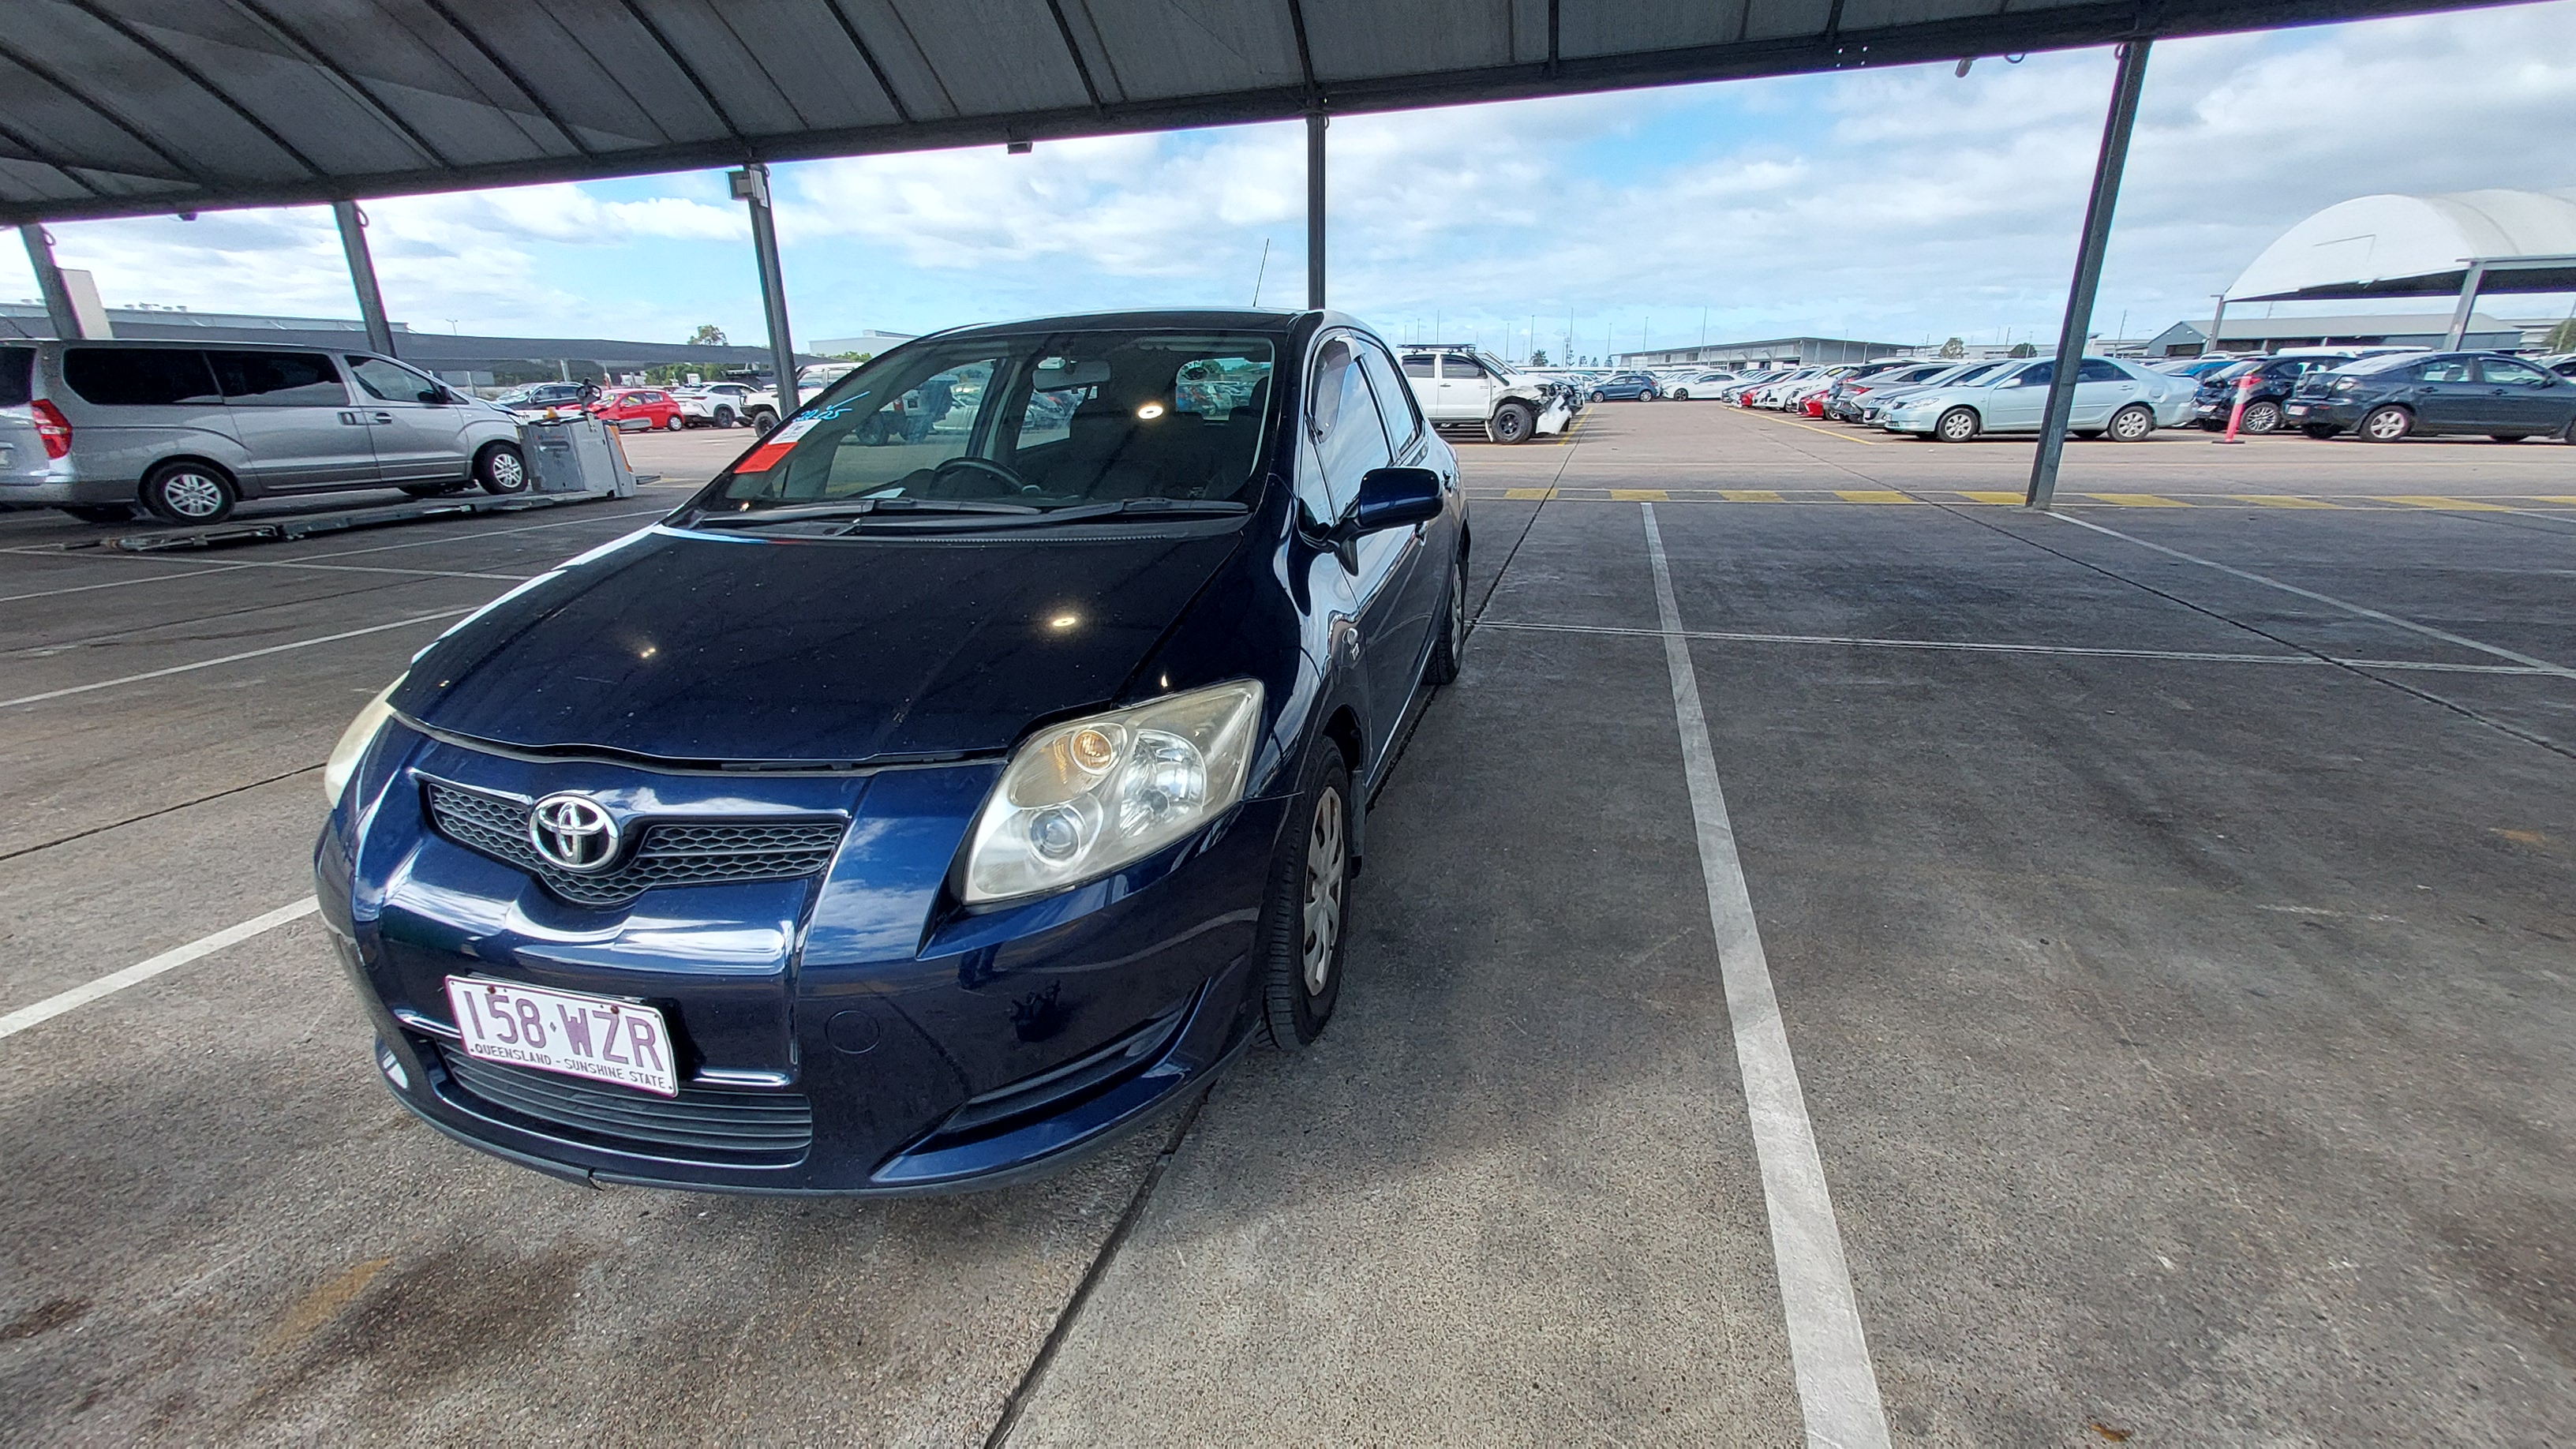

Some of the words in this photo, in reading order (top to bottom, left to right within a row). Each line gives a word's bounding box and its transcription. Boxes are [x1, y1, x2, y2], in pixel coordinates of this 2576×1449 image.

[463, 990, 547, 1049] 158
[556, 1003, 665, 1072] WZR
[474, 1043, 552, 1065] QUEENSLAND
[564, 1058, 624, 1080] SUNSHINE
[629, 1071, 666, 1089] STATE
